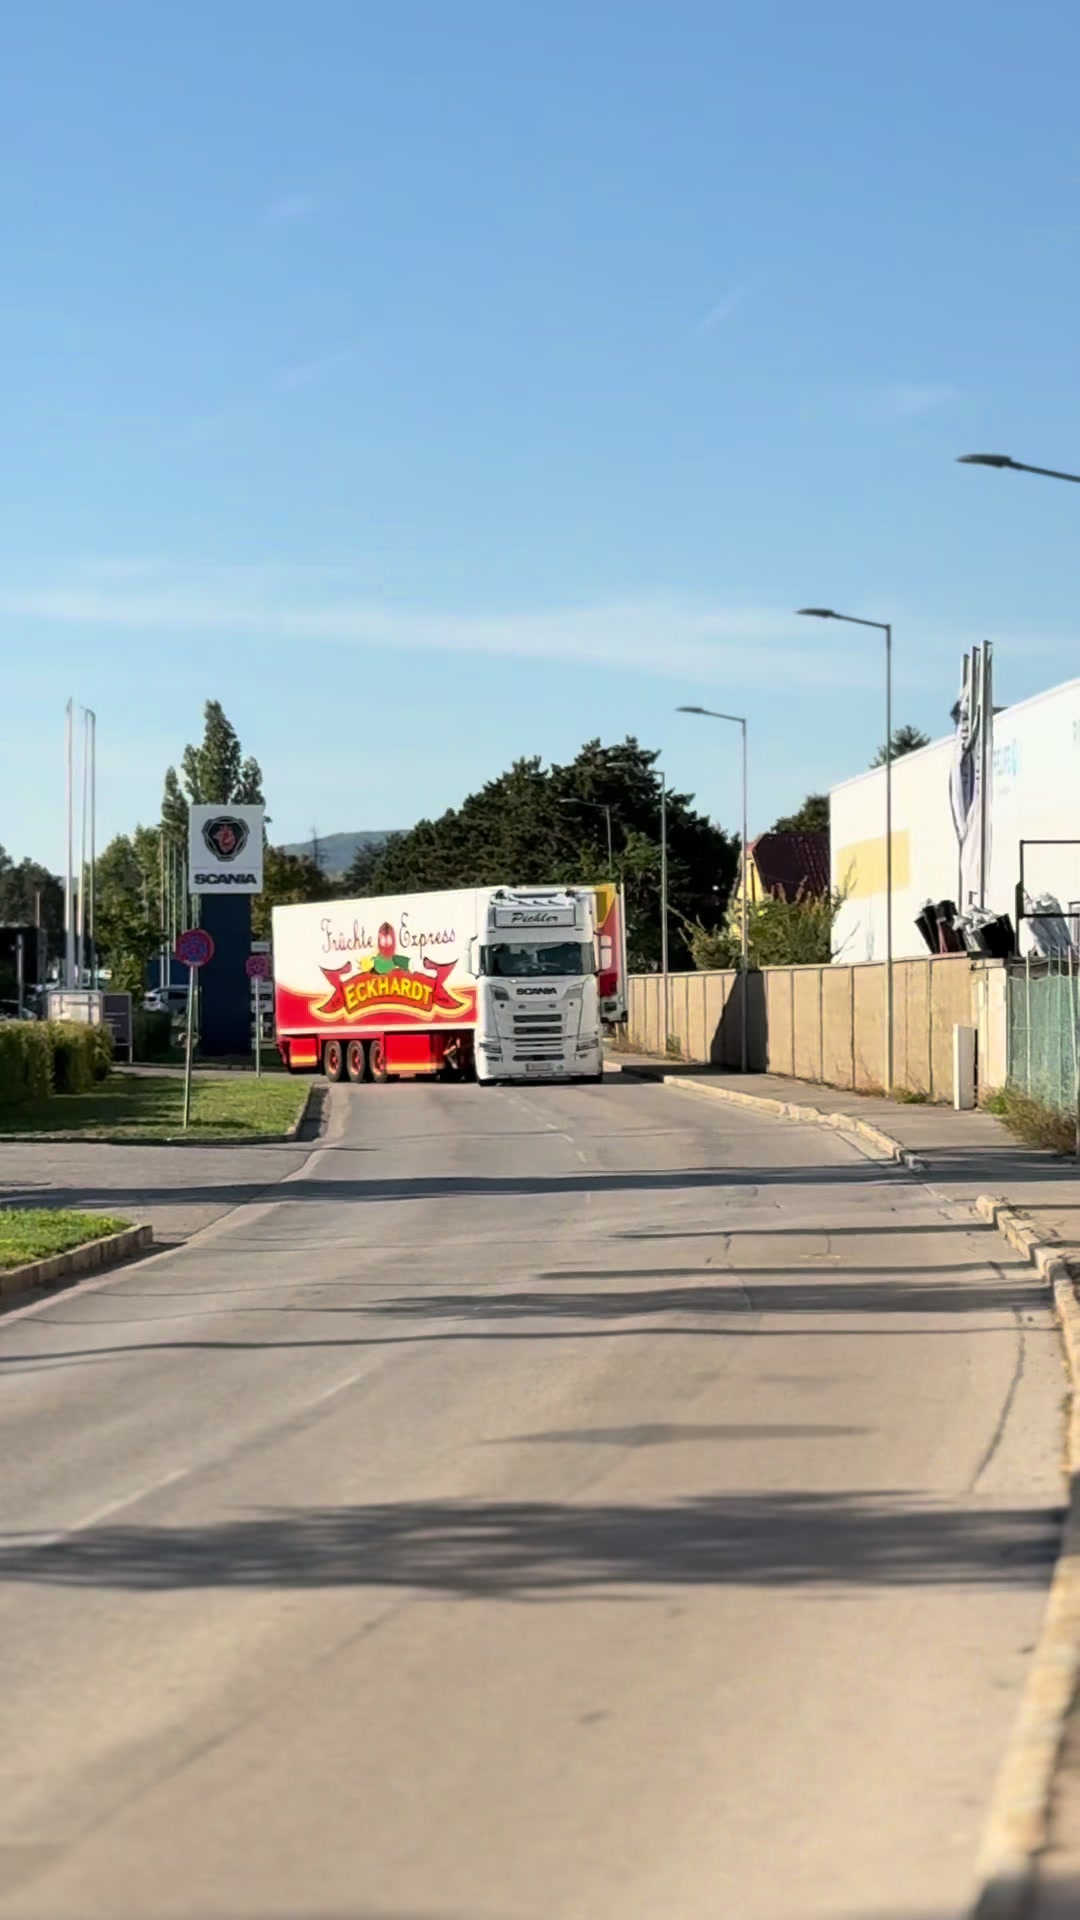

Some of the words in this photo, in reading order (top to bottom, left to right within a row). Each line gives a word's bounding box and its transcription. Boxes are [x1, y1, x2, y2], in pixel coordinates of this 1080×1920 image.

[194, 873, 257, 885] SCANIA
[322, 918, 373, 953] Früchte
[399, 912, 455, 959] Express
[344, 976, 432, 1009] ECKHARDT
[516, 987, 557, 996] SCANIA
